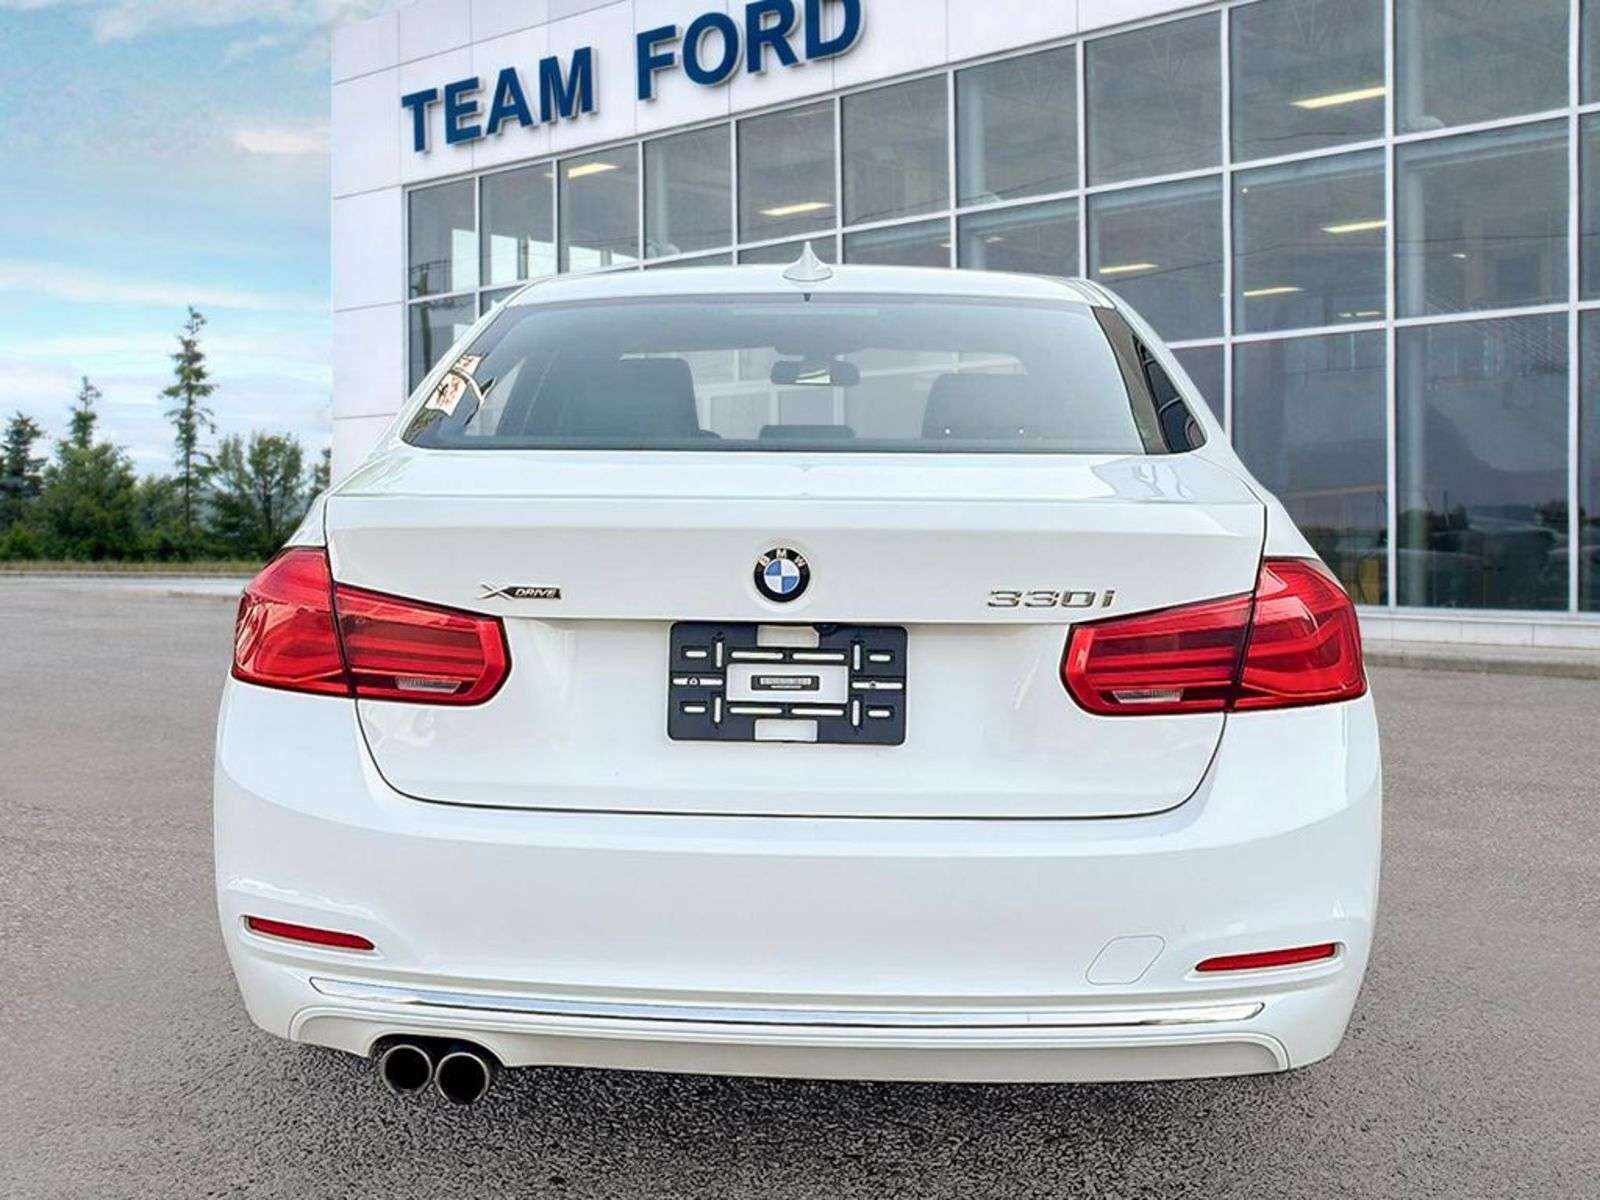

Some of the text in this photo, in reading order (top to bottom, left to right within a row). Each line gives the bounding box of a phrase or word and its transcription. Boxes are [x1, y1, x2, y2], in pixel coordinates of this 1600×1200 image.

[401, 0, 862, 152] TEAM FORD
[759, 548, 806, 567] BMW
[987, 590, 1116, 608] 330i
